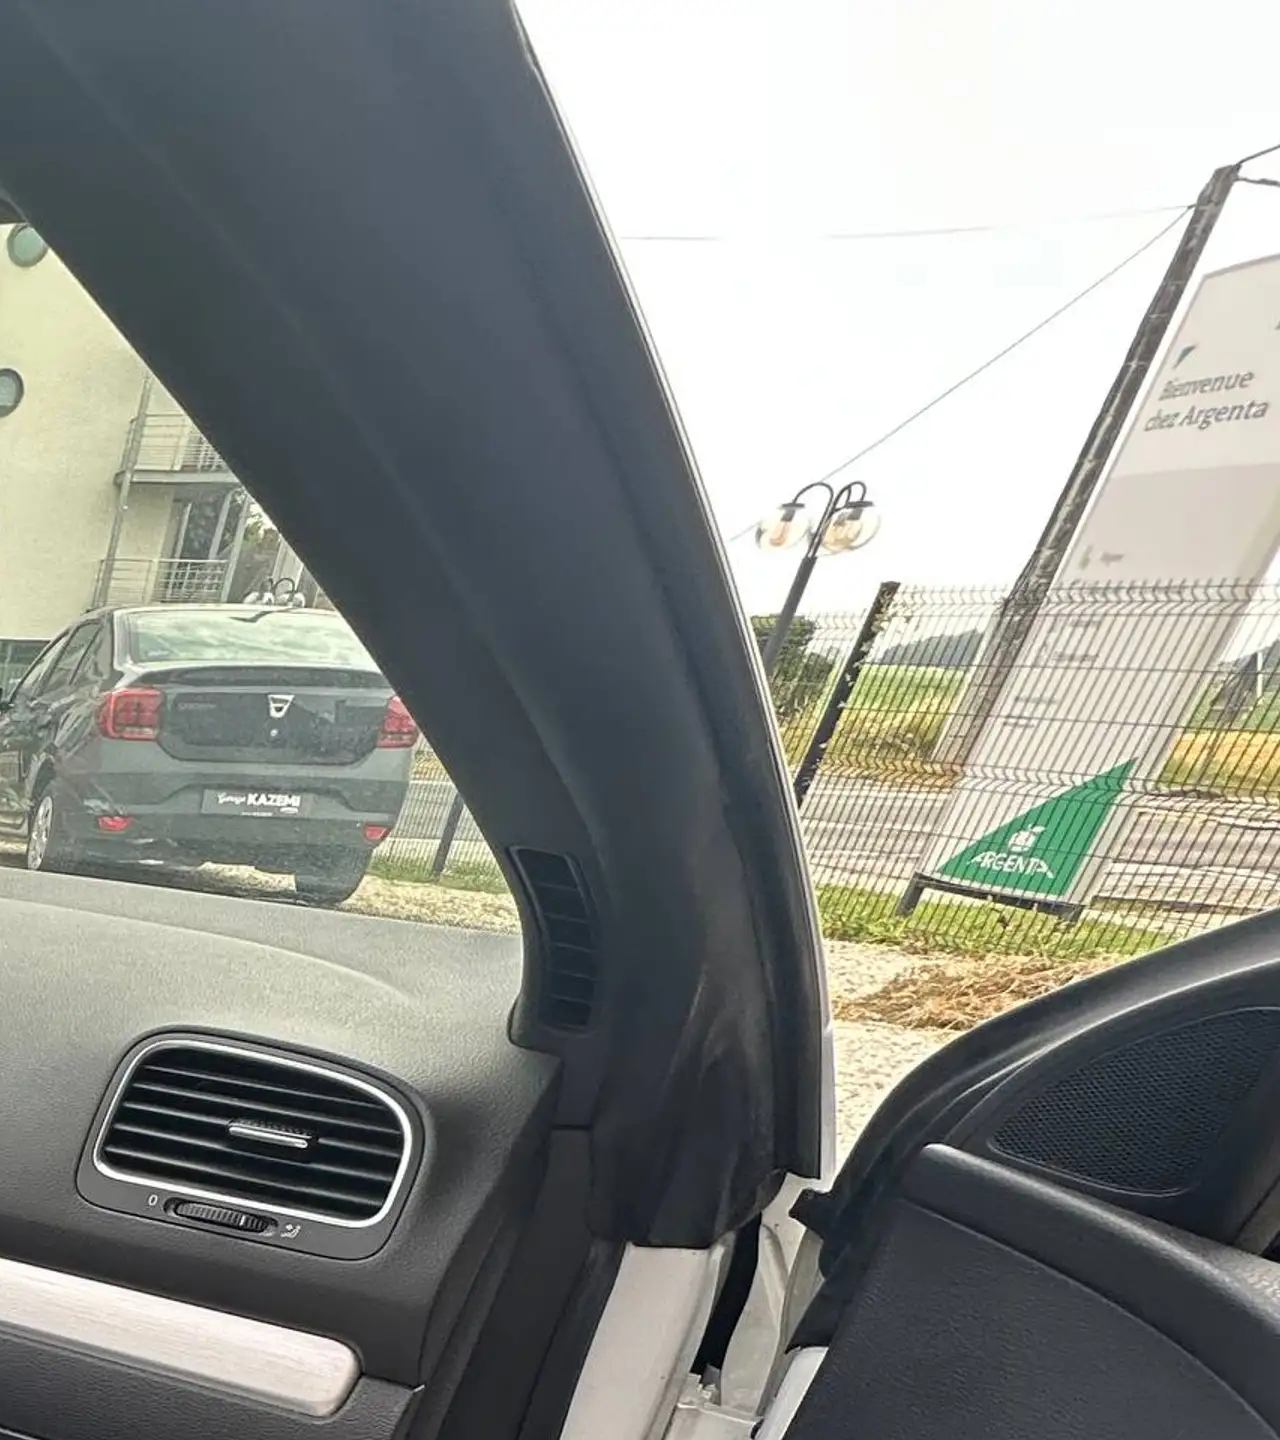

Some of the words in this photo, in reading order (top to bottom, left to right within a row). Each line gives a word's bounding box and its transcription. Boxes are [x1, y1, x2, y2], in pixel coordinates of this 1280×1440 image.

[1178, 399, 1270, 431] Argenta
[246, 792, 301, 807] KAZEMI
[966, 850, 1055, 879] ARGENTA
